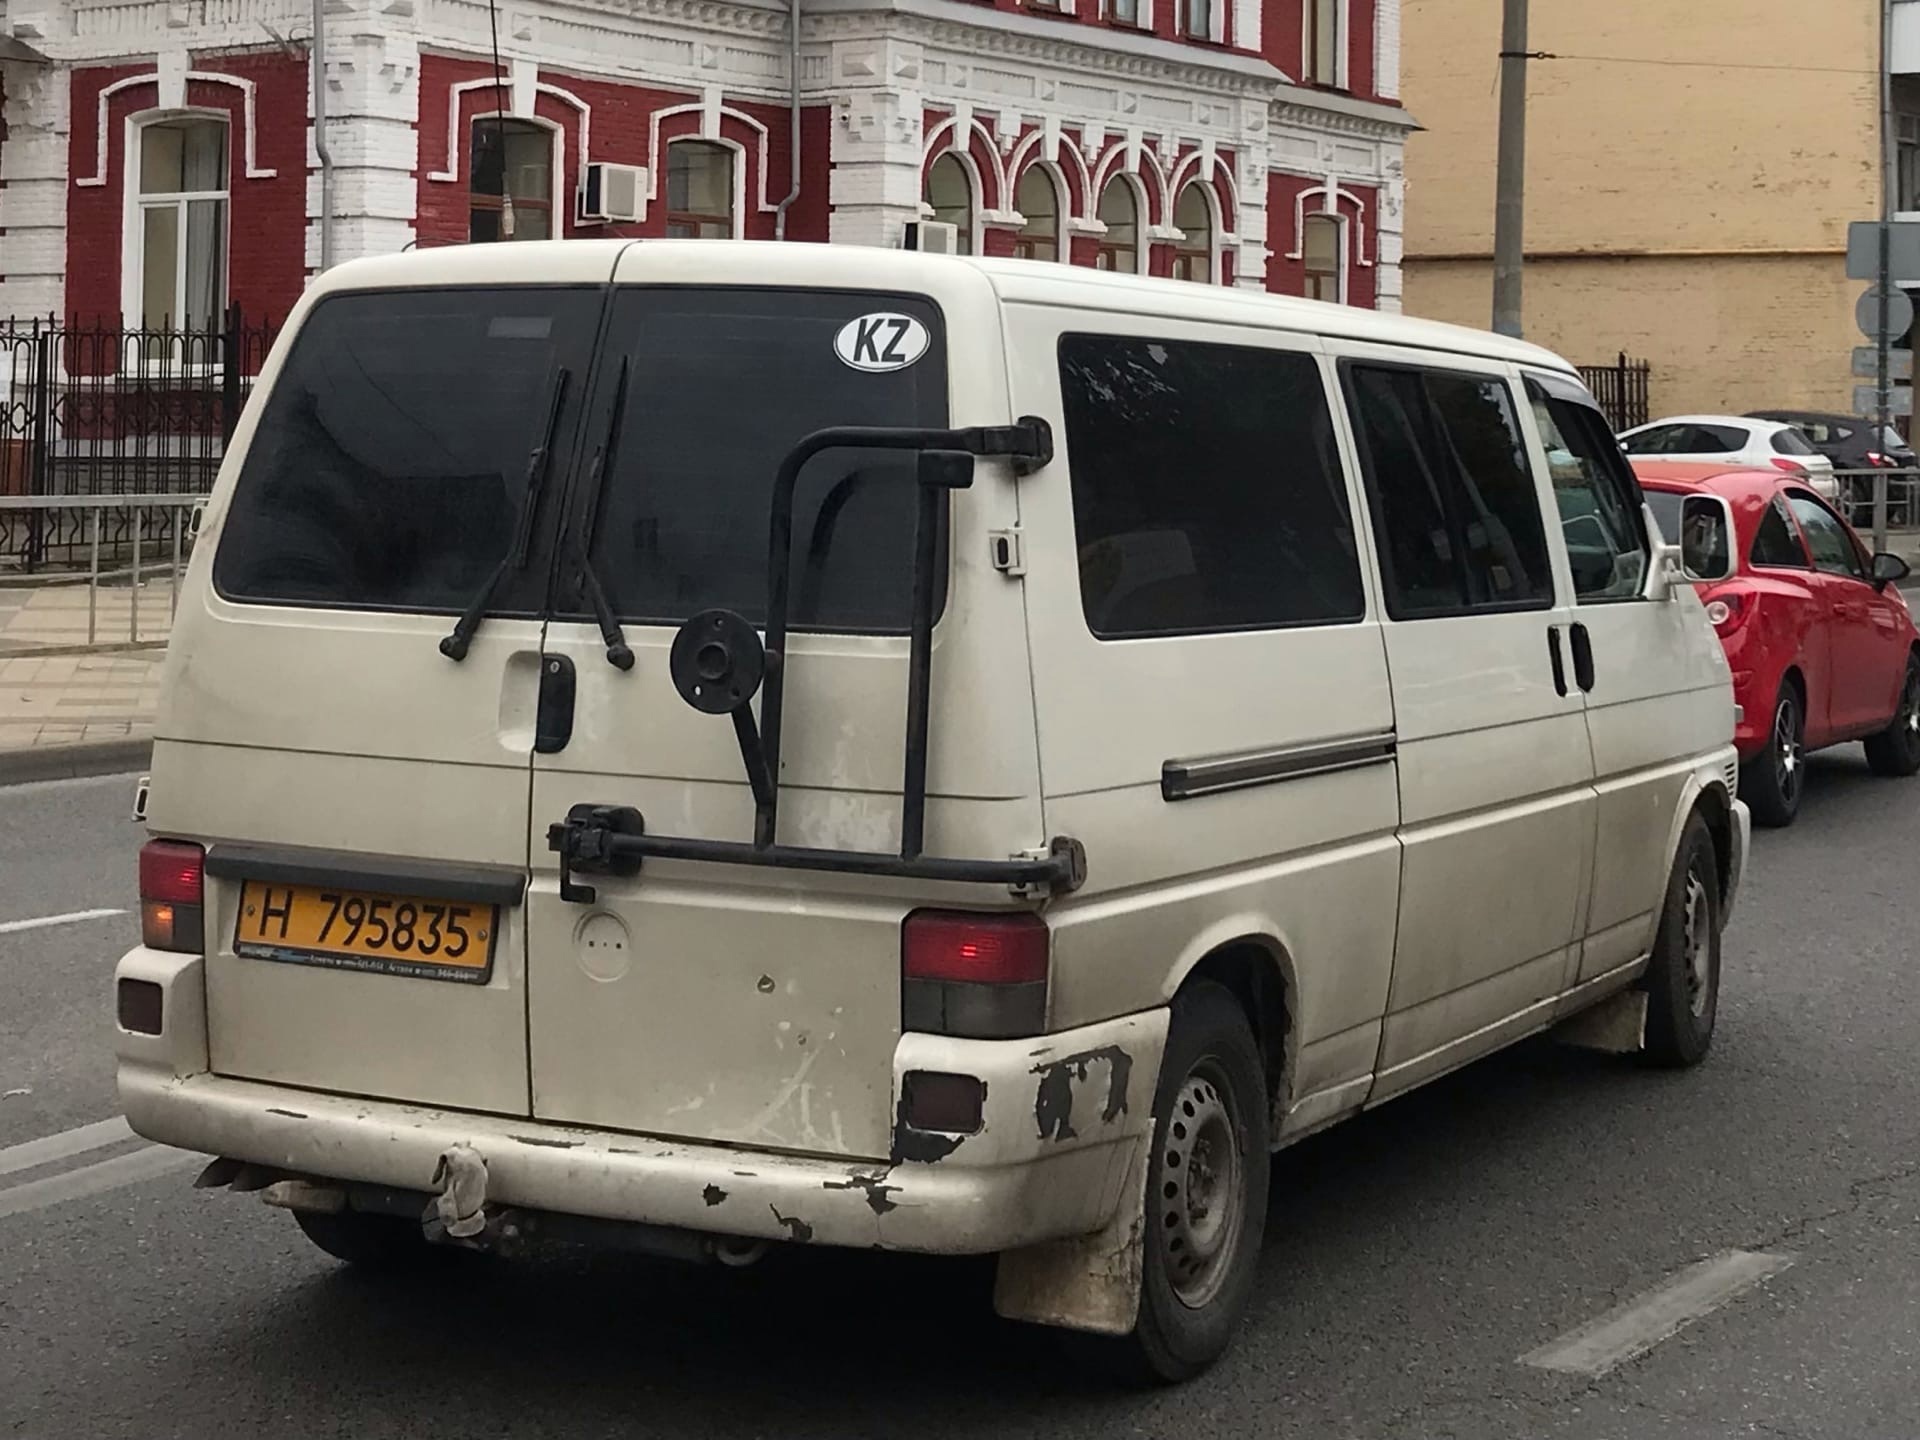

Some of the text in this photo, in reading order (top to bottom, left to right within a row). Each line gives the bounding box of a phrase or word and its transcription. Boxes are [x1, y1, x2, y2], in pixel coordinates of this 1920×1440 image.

[853, 318, 911, 363] KZ
[259, 887, 471, 958] H 795835
